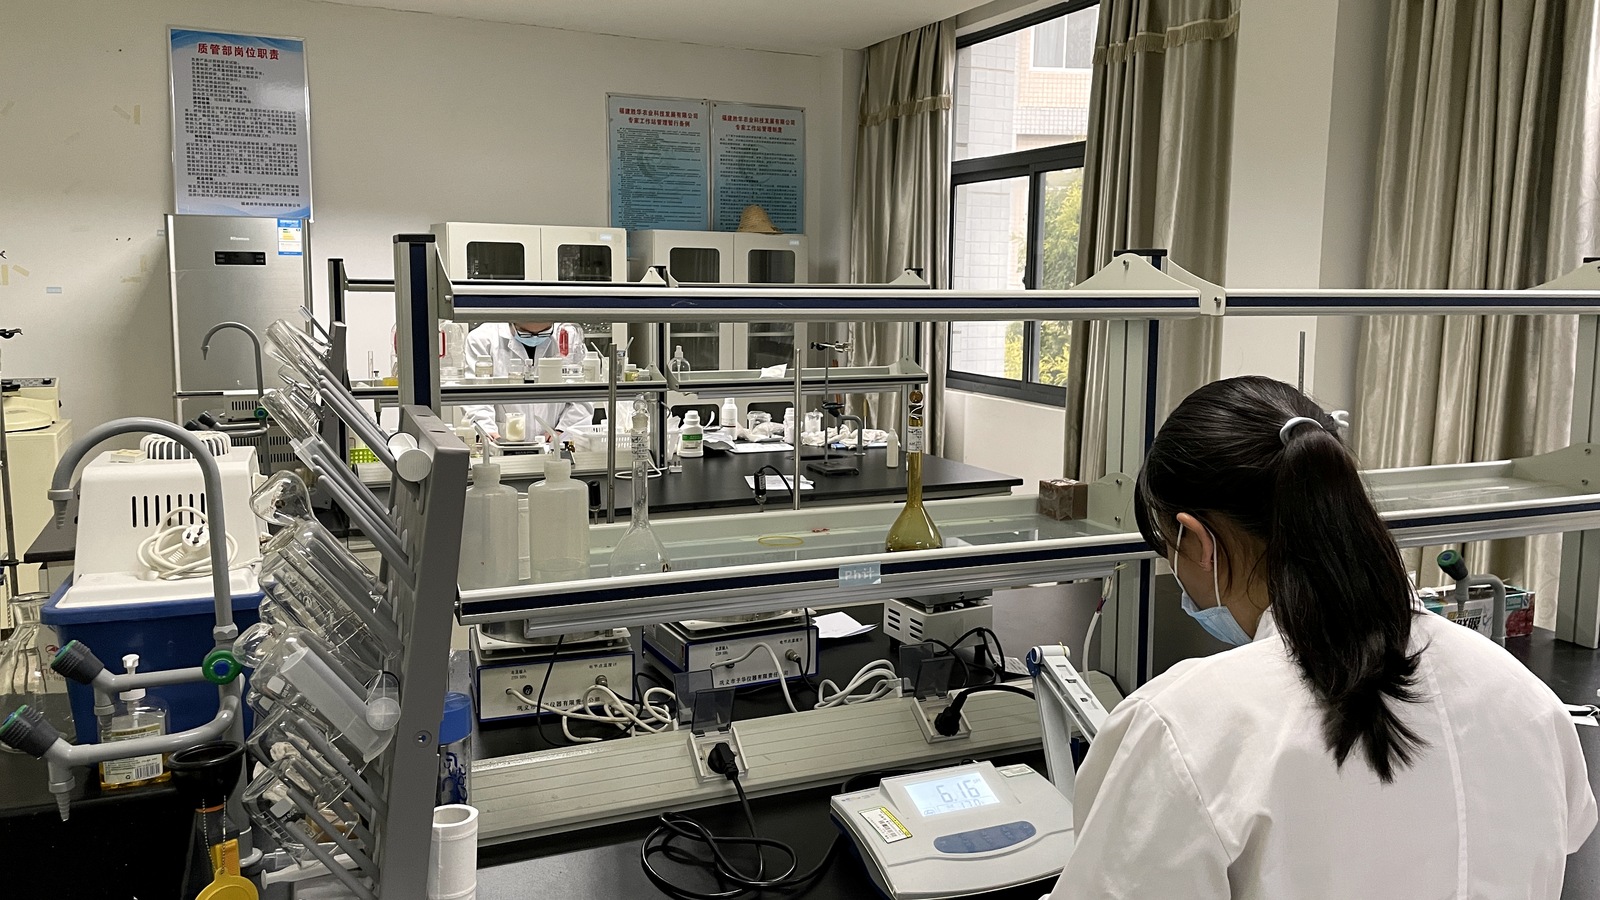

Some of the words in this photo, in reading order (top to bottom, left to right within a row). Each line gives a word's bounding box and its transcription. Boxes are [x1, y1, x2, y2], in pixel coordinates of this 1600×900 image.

[198, 43, 280, 60] 质管部岗位职责
[719, 670, 789, 686] 巩义市予华仪器有限责任司
[936, 780, 981, 803] 6.16
